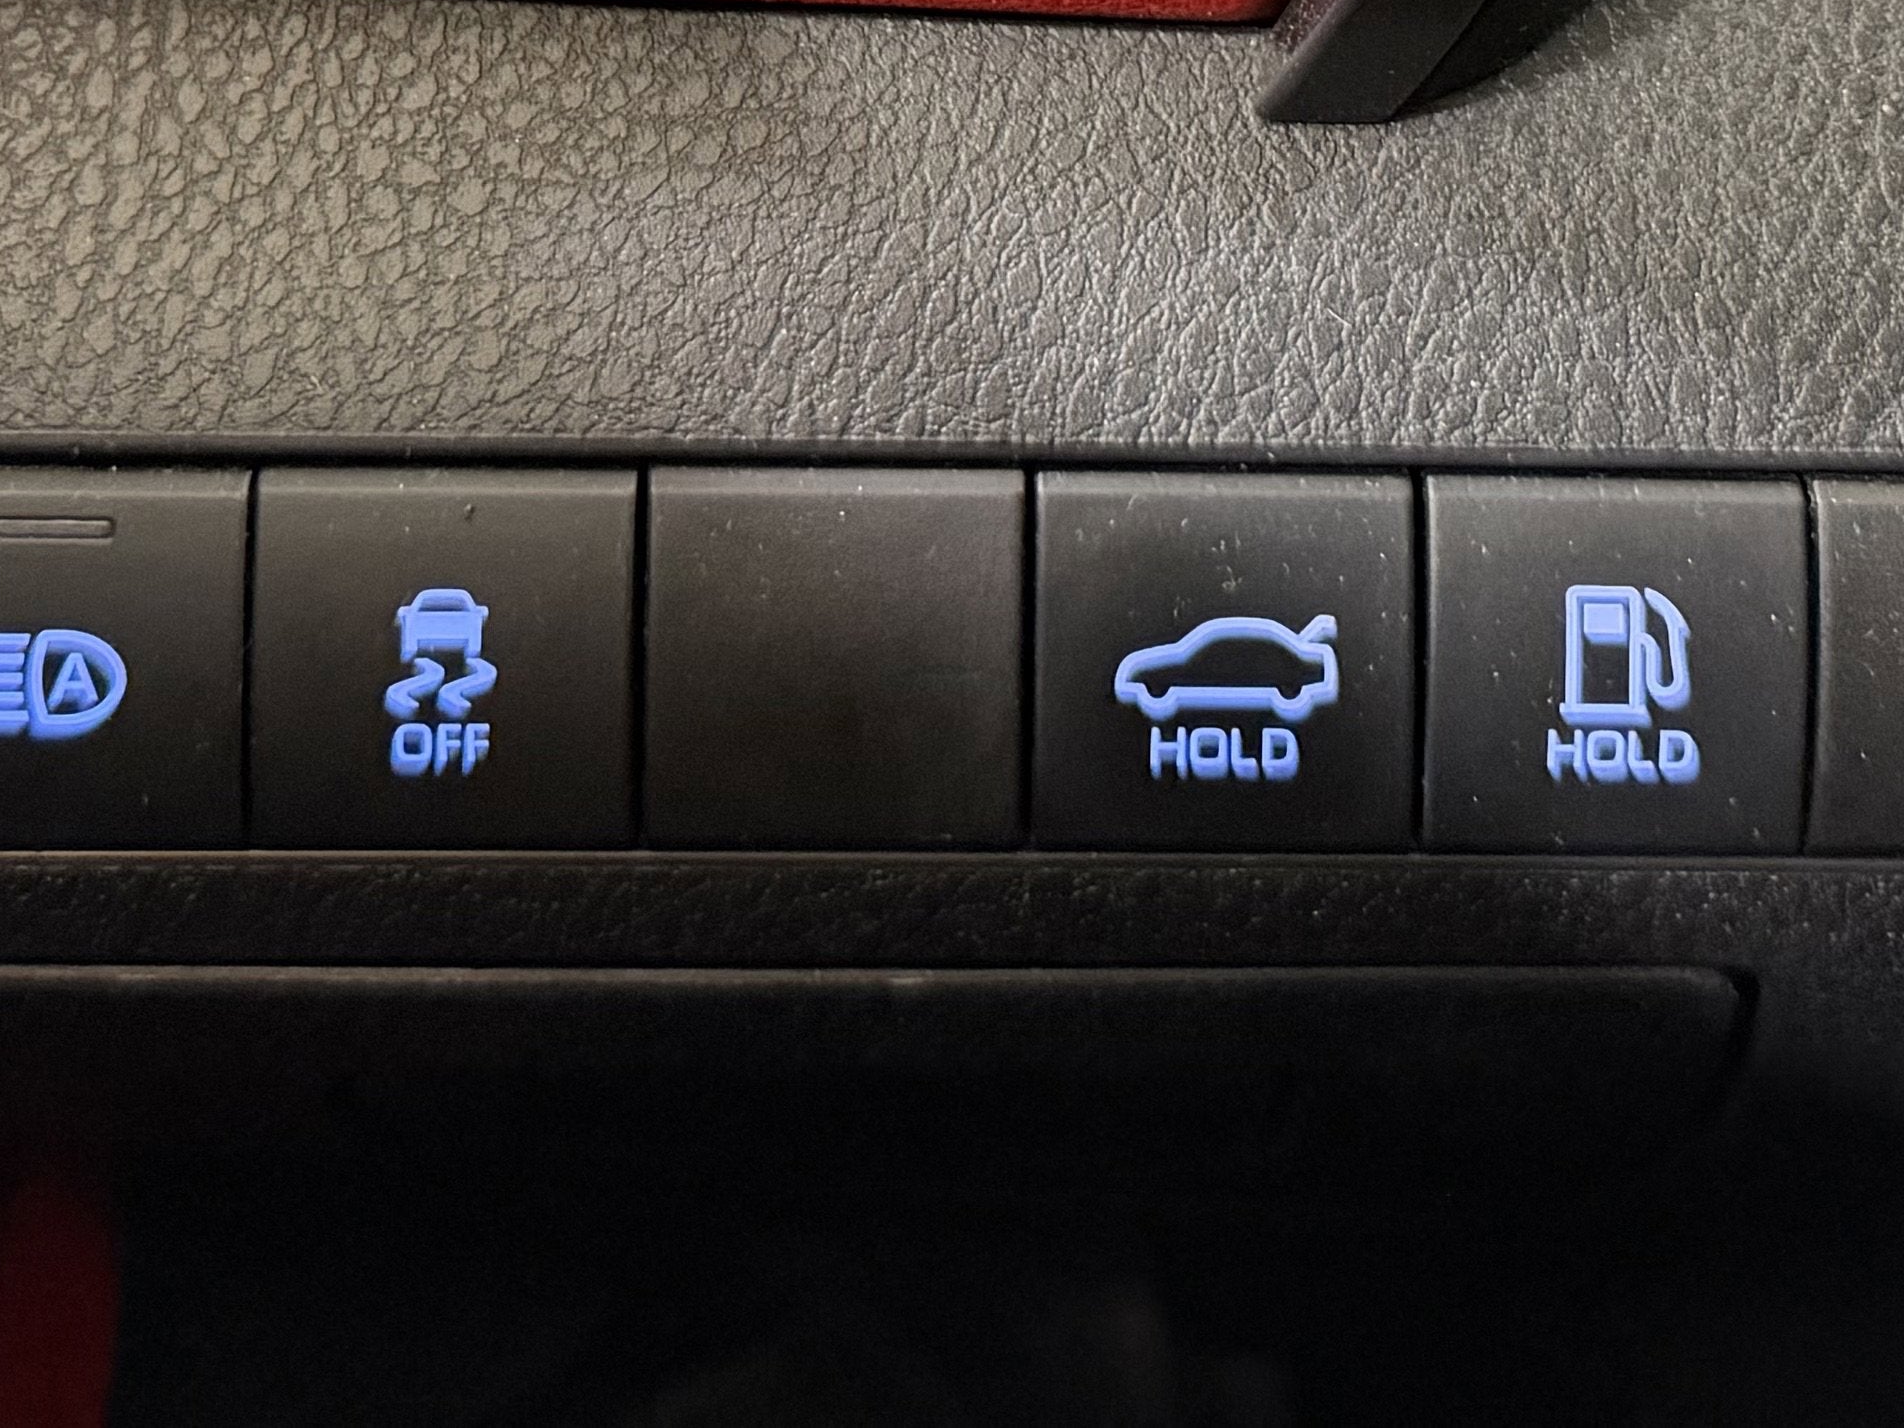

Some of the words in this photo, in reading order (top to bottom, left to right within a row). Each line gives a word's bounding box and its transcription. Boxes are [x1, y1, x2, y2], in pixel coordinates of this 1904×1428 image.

[390, 722, 490, 776] OFF
[1149, 726, 1298, 780] HOLD
[1546, 729, 1700, 784] HOLD
